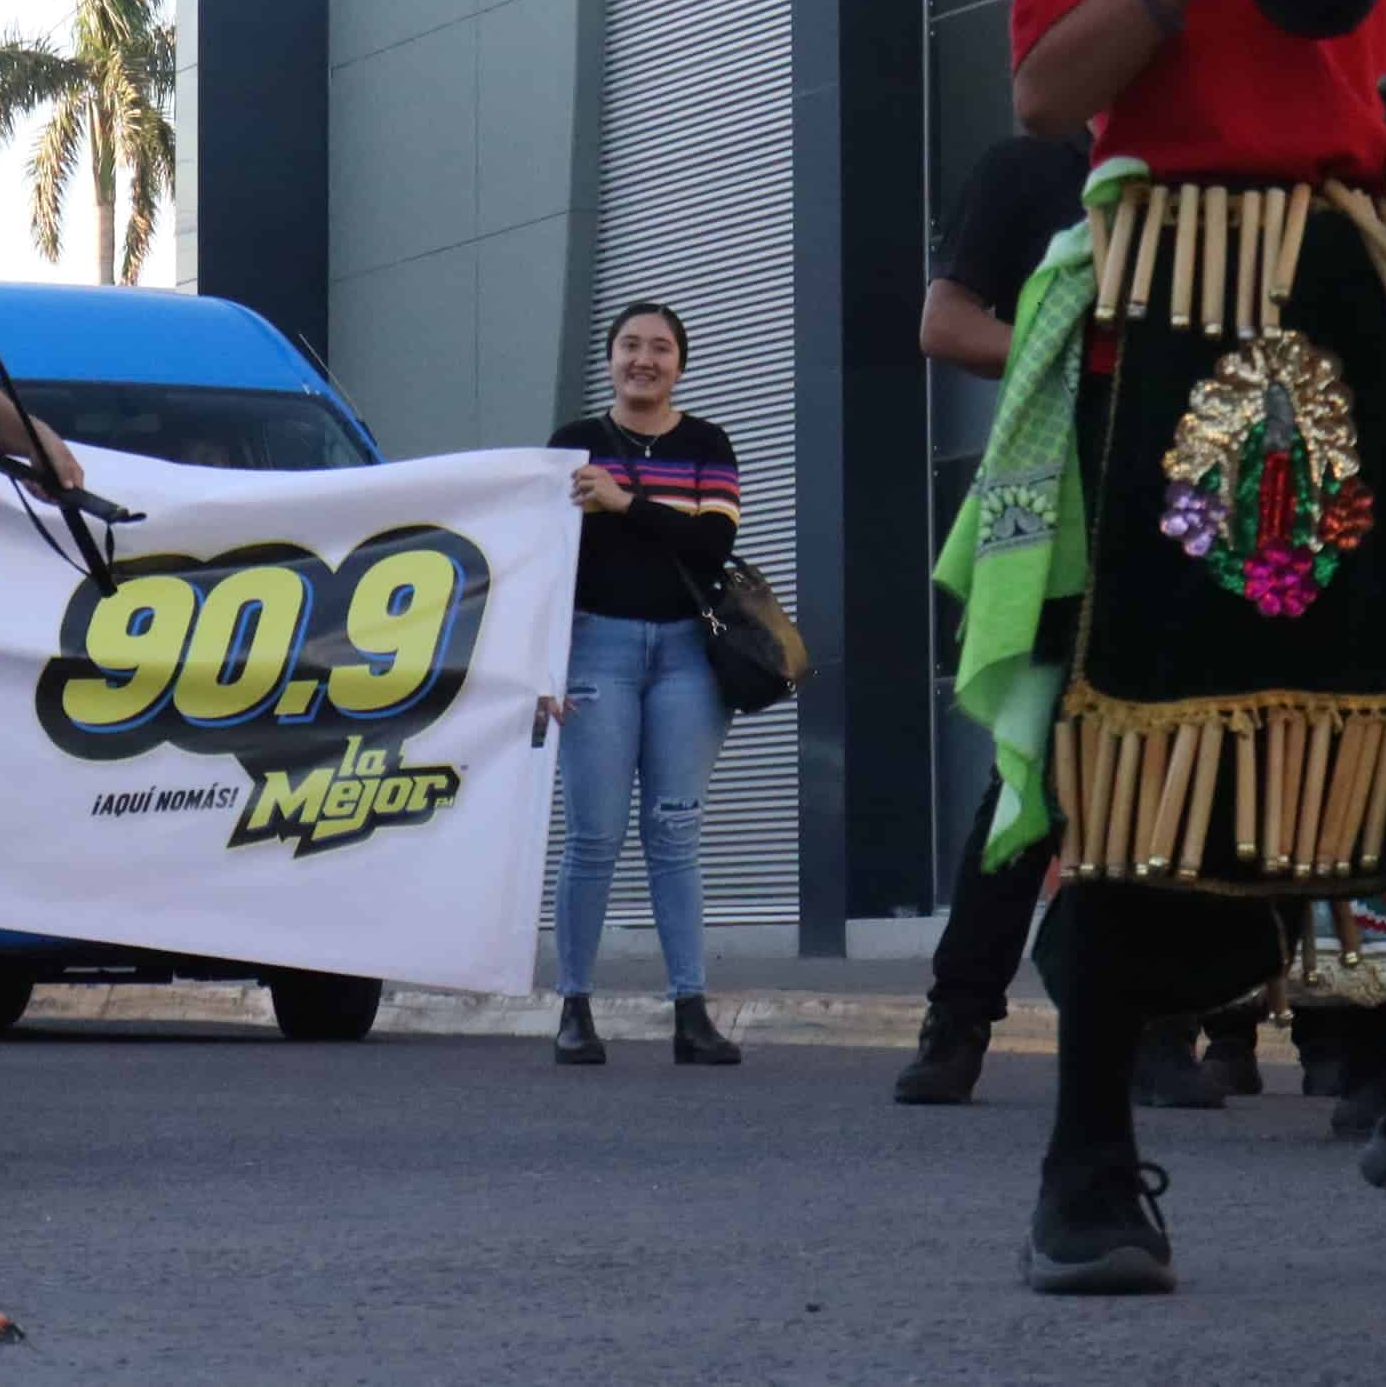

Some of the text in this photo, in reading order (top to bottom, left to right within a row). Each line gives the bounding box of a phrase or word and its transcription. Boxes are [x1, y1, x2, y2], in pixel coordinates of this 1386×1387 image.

[62, 549, 465, 734] 90.9
[339, 734, 387, 778] la
[91, 782, 239, 817] ¡AQUÍ NOMÁS!
[247, 770, 448, 841] Mejor
